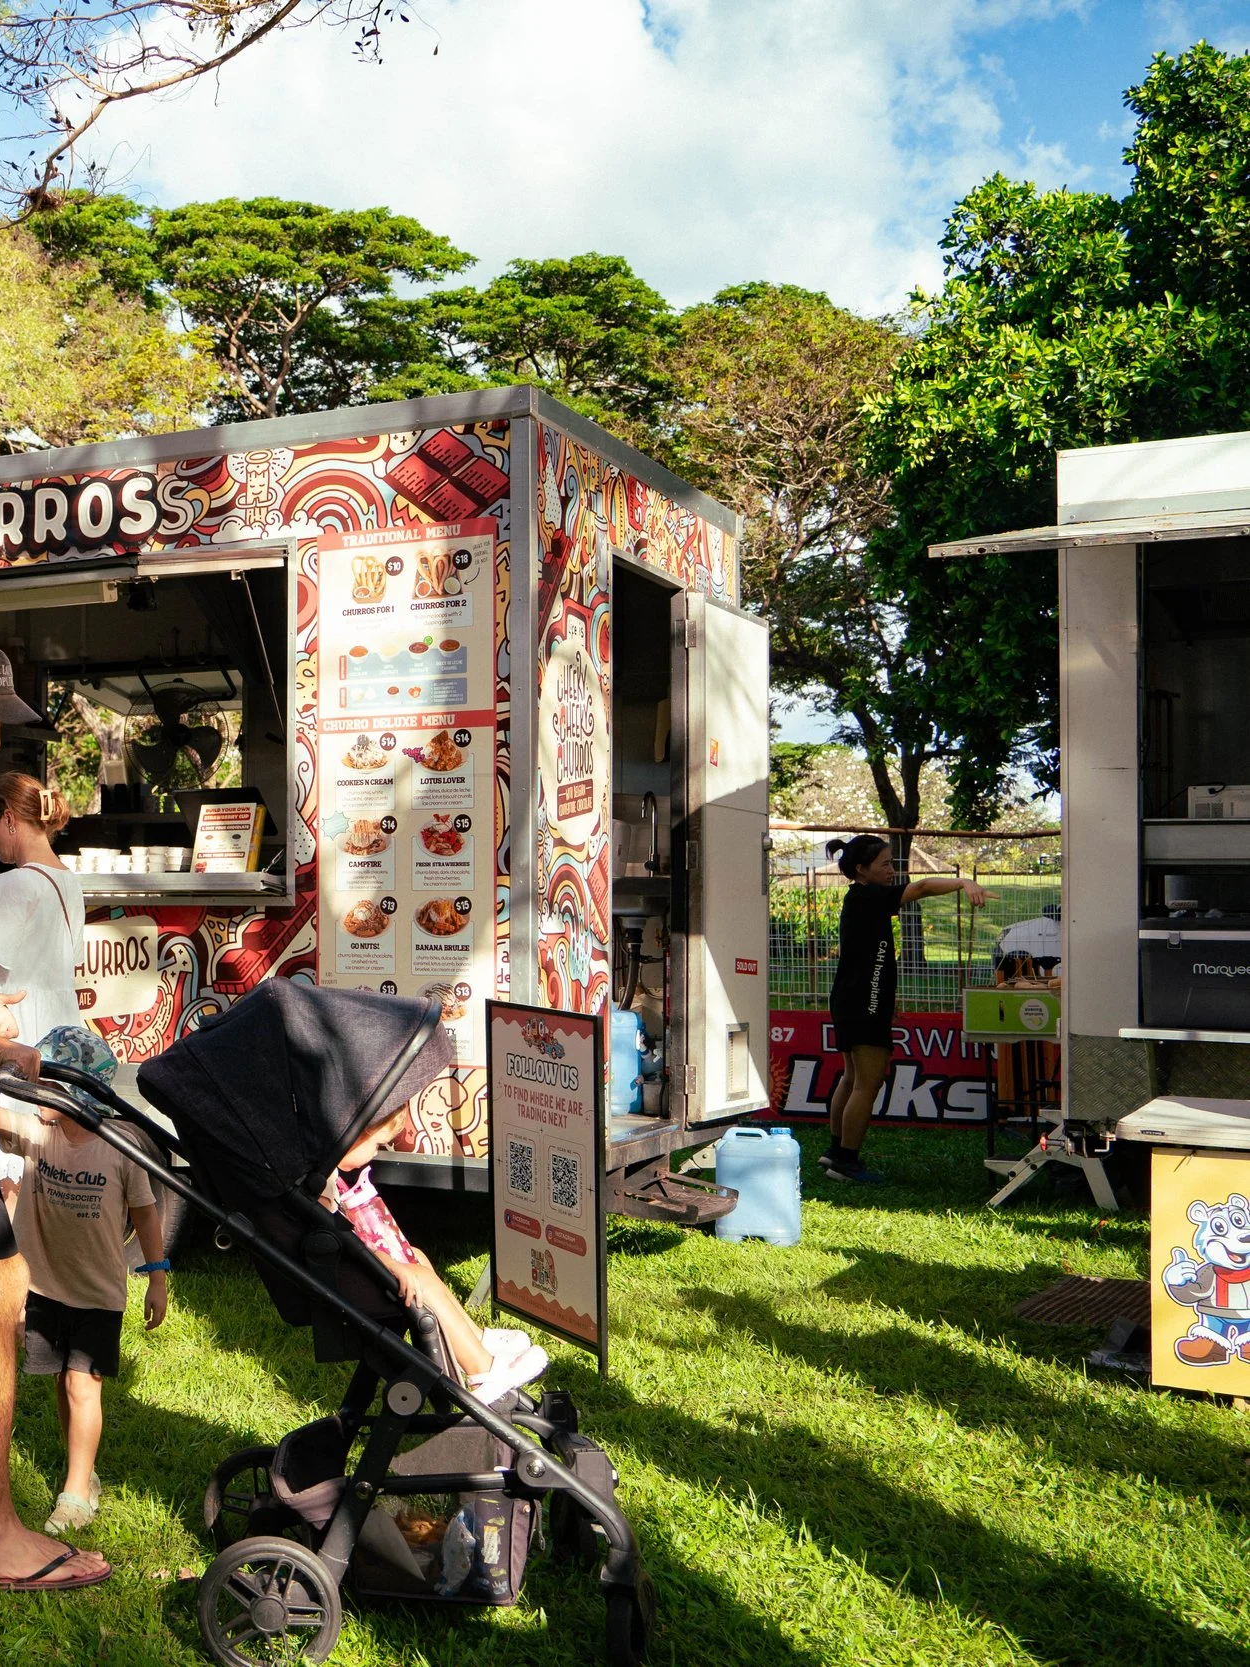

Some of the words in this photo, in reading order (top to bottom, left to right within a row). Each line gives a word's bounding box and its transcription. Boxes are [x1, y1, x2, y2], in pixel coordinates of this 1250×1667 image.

[342, 529, 421, 547] TRADITIONAL
[425, 524, 461, 538] MENU
[455, 554, 469, 564] $18
[387, 561, 401, 572] $10
[410, 601, 445, 611] CHURROS
[445, 600, 460, 608] FOR
[461, 599, 467, 607] 2
[342, 606, 376, 617] CHURROS
[376, 605, 391, 614] FOR
[556, 651, 588, 703] CHEEKY
[322, 718, 368, 731] CHURRO
[372, 716, 417, 729] DELUXE
[421, 713, 456, 727] MENU
[553, 695, 595, 744] CHEEKY
[381, 737, 395, 747] $14
[455, 733, 470, 743] $14
[556, 741, 593, 784] CHURROS
[336, 779, 364, 787] COOKIES
[364, 778, 370, 786] N
[370, 777, 394, 786] CREAM
[420, 777, 442, 785] LOTUS
[442, 776, 466, 784] LOVER
[381, 820, 396, 830] $14
[455, 818, 470, 828] $15
[348, 860, 382, 868] CAMPFIRE
[381, 899, 396, 911] $13
[455, 900, 470, 911] $15
[350, 942, 359, 950] GO
[360, 942, 380, 950] NUTS!
[415, 943, 443, 952] BANANA
[443, 944, 470, 952] BRULEE
[876, 940, 888, 962] CAH
[736, 961, 748, 971] SOLD
[748, 962, 757, 972] OUT
[381, 985, 396, 994] $13
[455, 987, 470, 996] $13
[868, 964, 883, 1015] hospitality.
[506, 1053, 559, 1086] FOLLOW
[560, 1064, 579, 1091] US
[503, 1084, 512, 1098] TO
[513, 1086, 529, 1102] FIND
[529, 1089, 553, 1109] WHERE
[555, 1096, 566, 1112] WE
[568, 1100, 583, 1116] ARE
[517, 1103, 547, 1124] TRADING
[548, 1113, 568, 1129] NEXT
[75, 1171, 107, 1186] Club
[60, 1200, 89, 1209] Angeles
